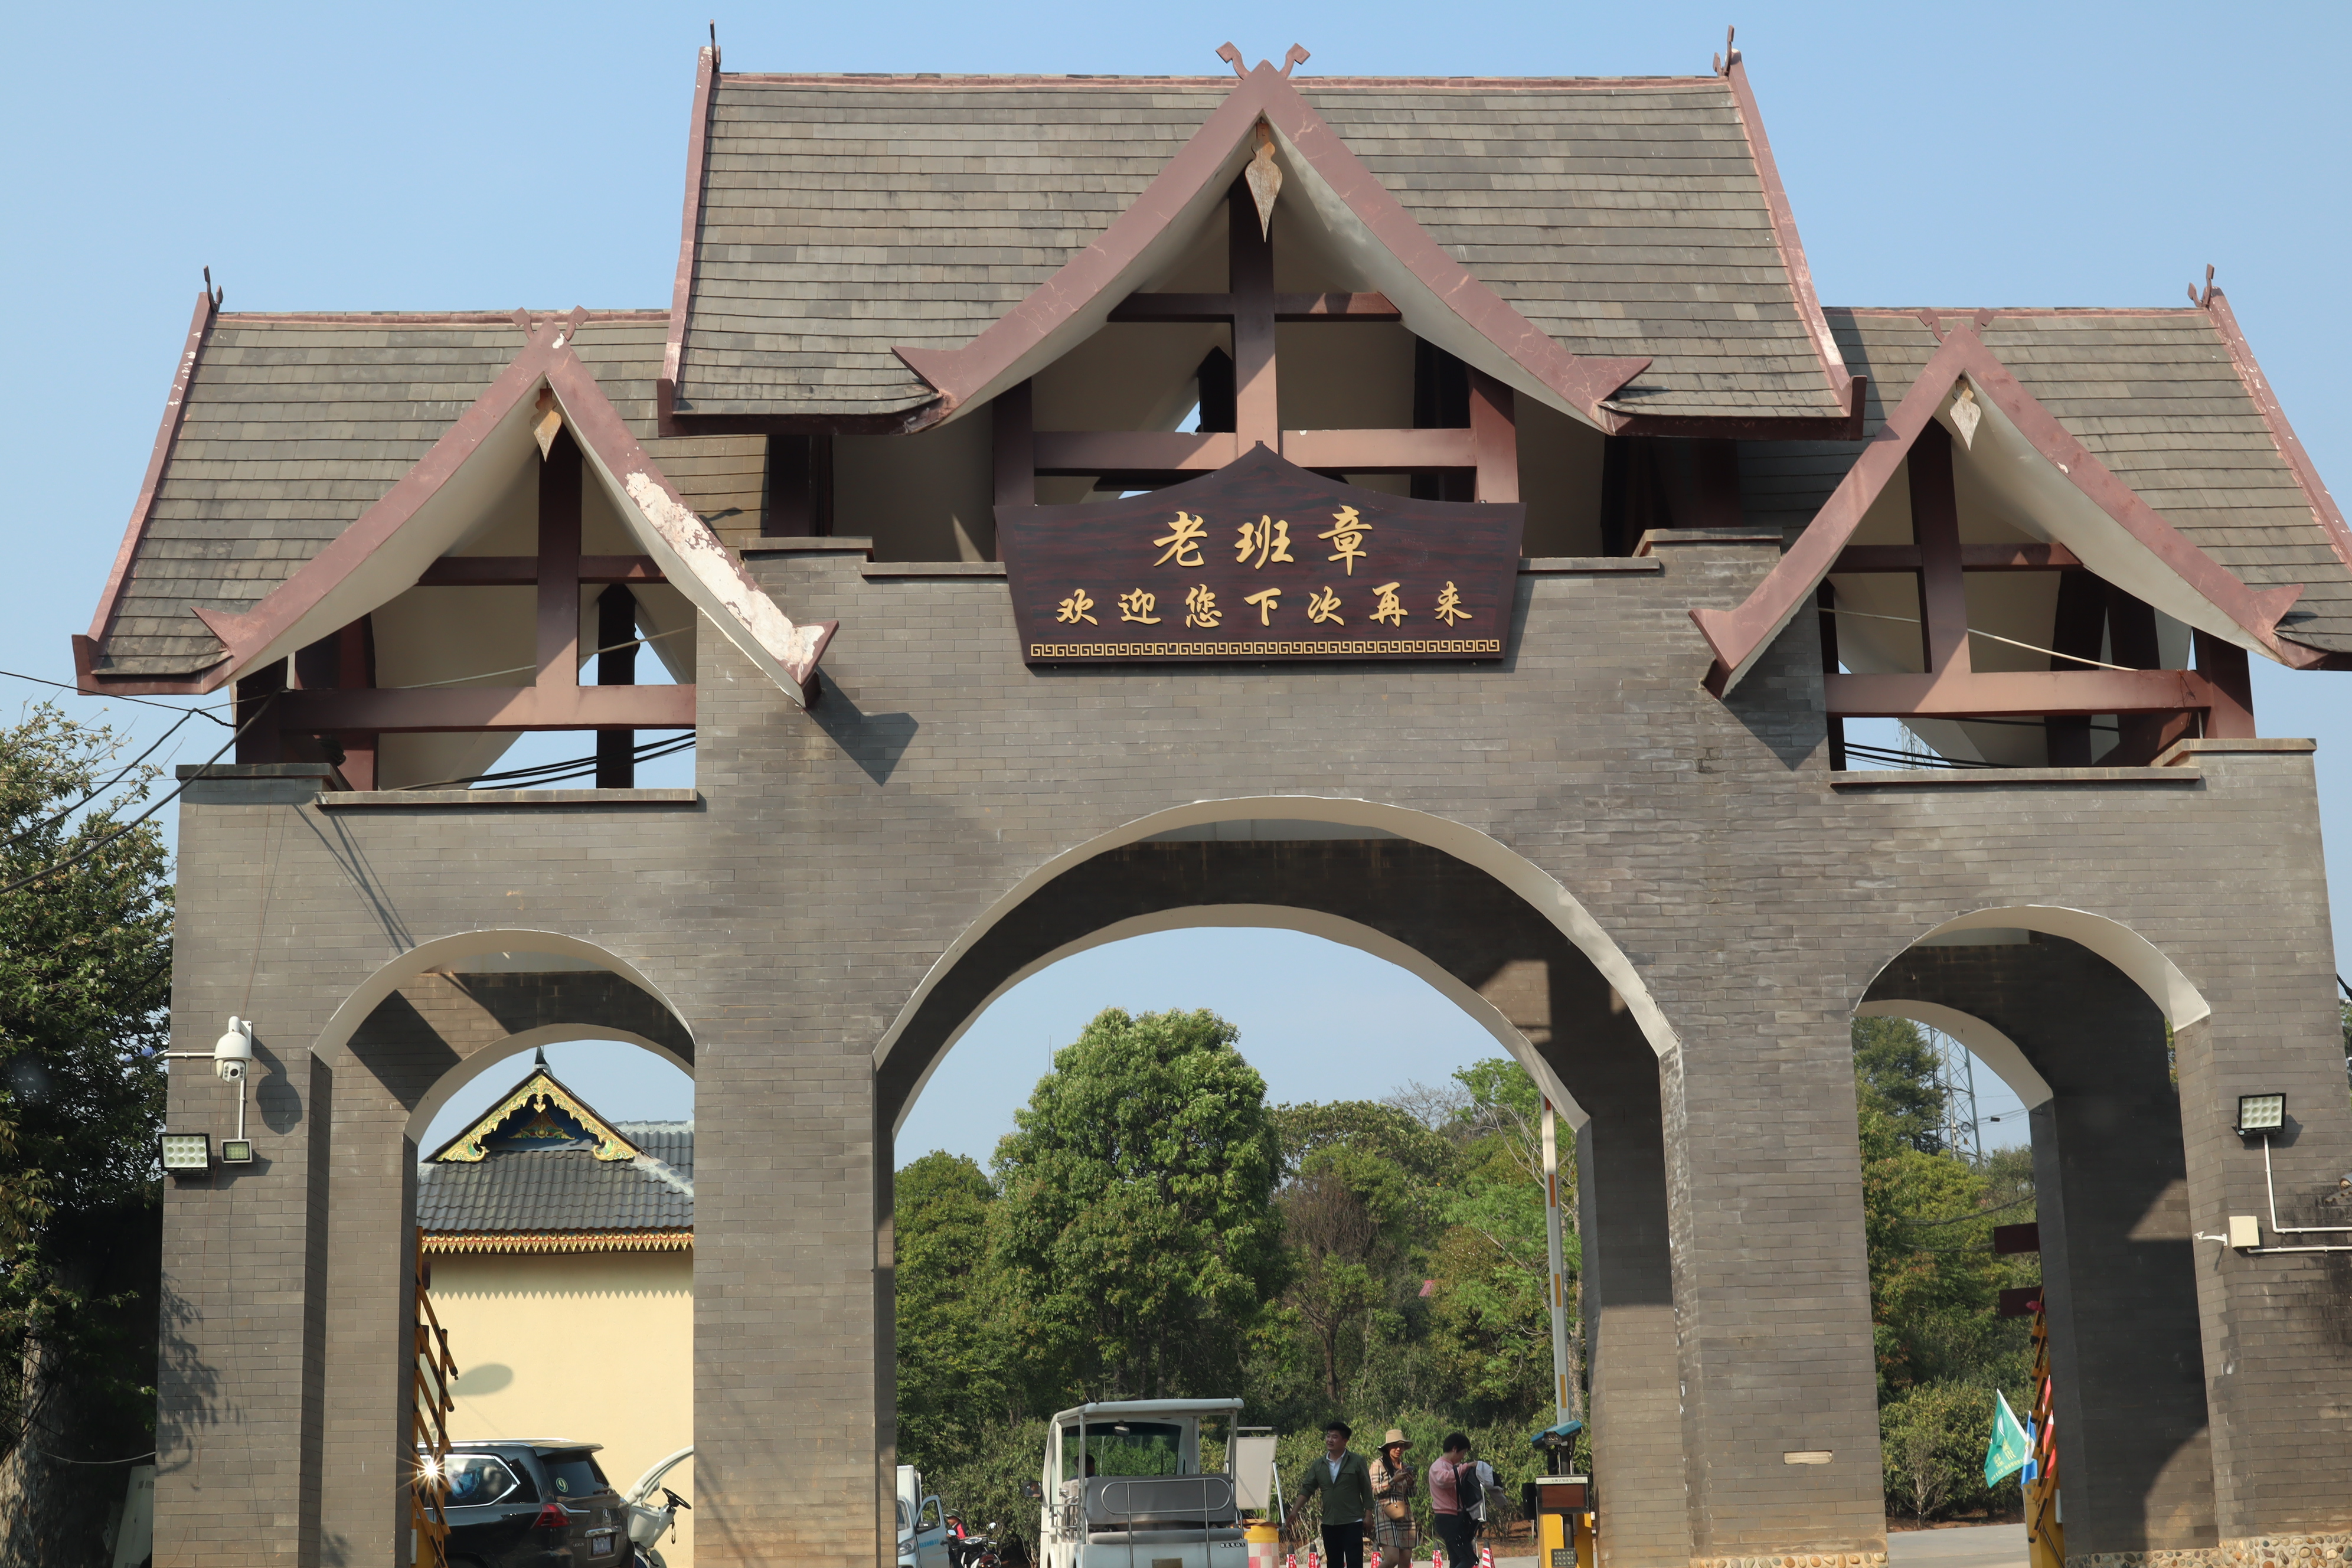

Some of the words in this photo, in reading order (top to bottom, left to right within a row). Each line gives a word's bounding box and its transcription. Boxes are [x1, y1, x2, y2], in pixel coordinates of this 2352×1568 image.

[1153, 505, 1373, 576] 老班章
[1056, 580, 1473, 628] 欢迎您下次再来
